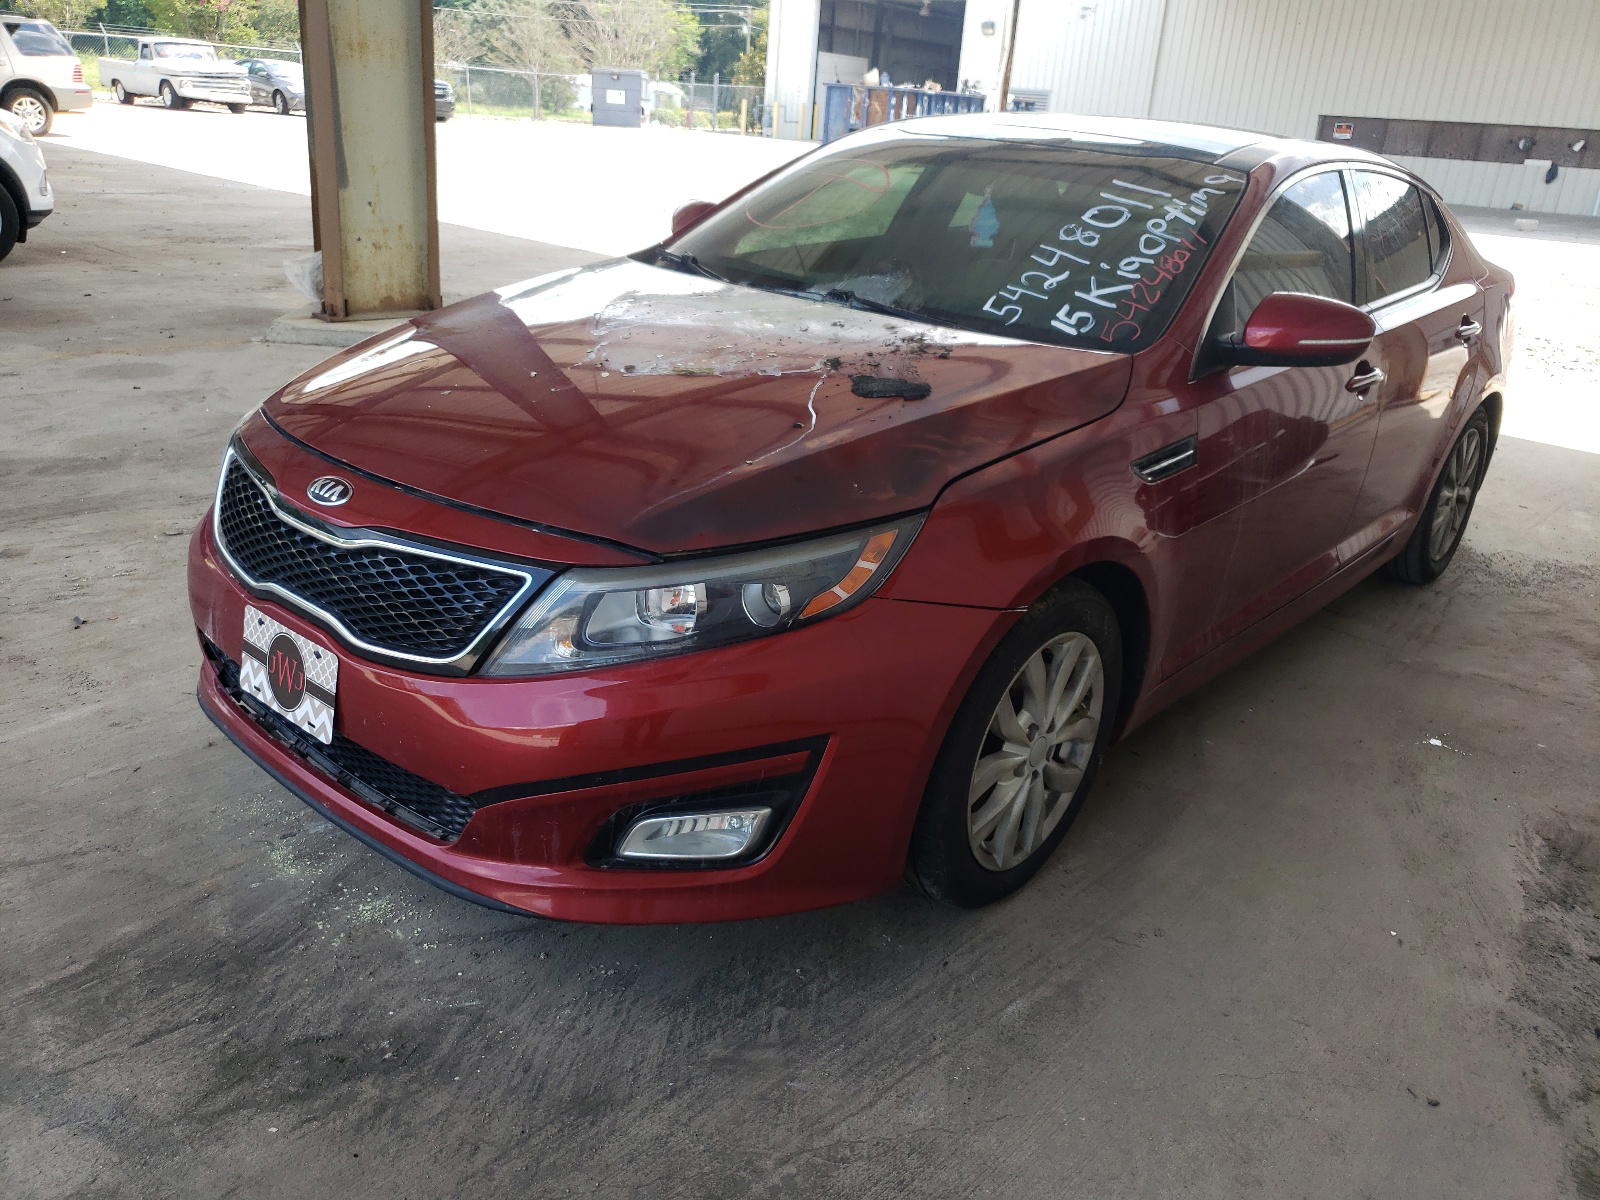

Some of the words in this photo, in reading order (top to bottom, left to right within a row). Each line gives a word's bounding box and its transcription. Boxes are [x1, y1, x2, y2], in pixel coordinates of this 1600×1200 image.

[983, 179, 1173, 325] 54248011
[1051, 304, 1096, 336] 15
[311, 478, 345, 502] KIA
